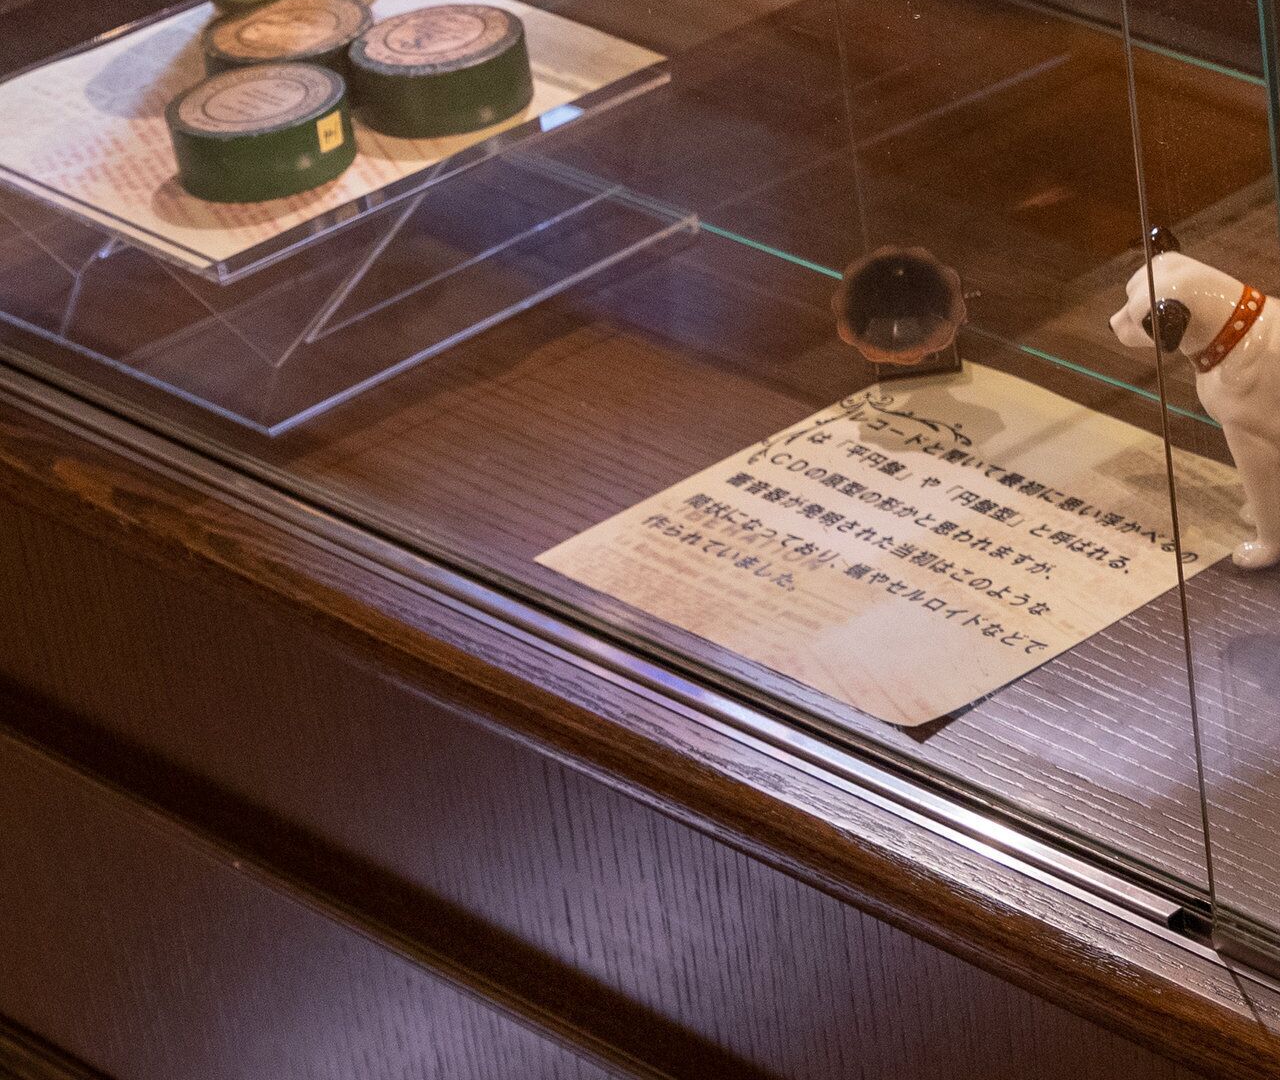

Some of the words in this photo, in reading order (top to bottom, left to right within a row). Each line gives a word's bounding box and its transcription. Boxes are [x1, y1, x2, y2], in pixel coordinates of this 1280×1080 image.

[641, 513, 796, 593] 作られていました。
